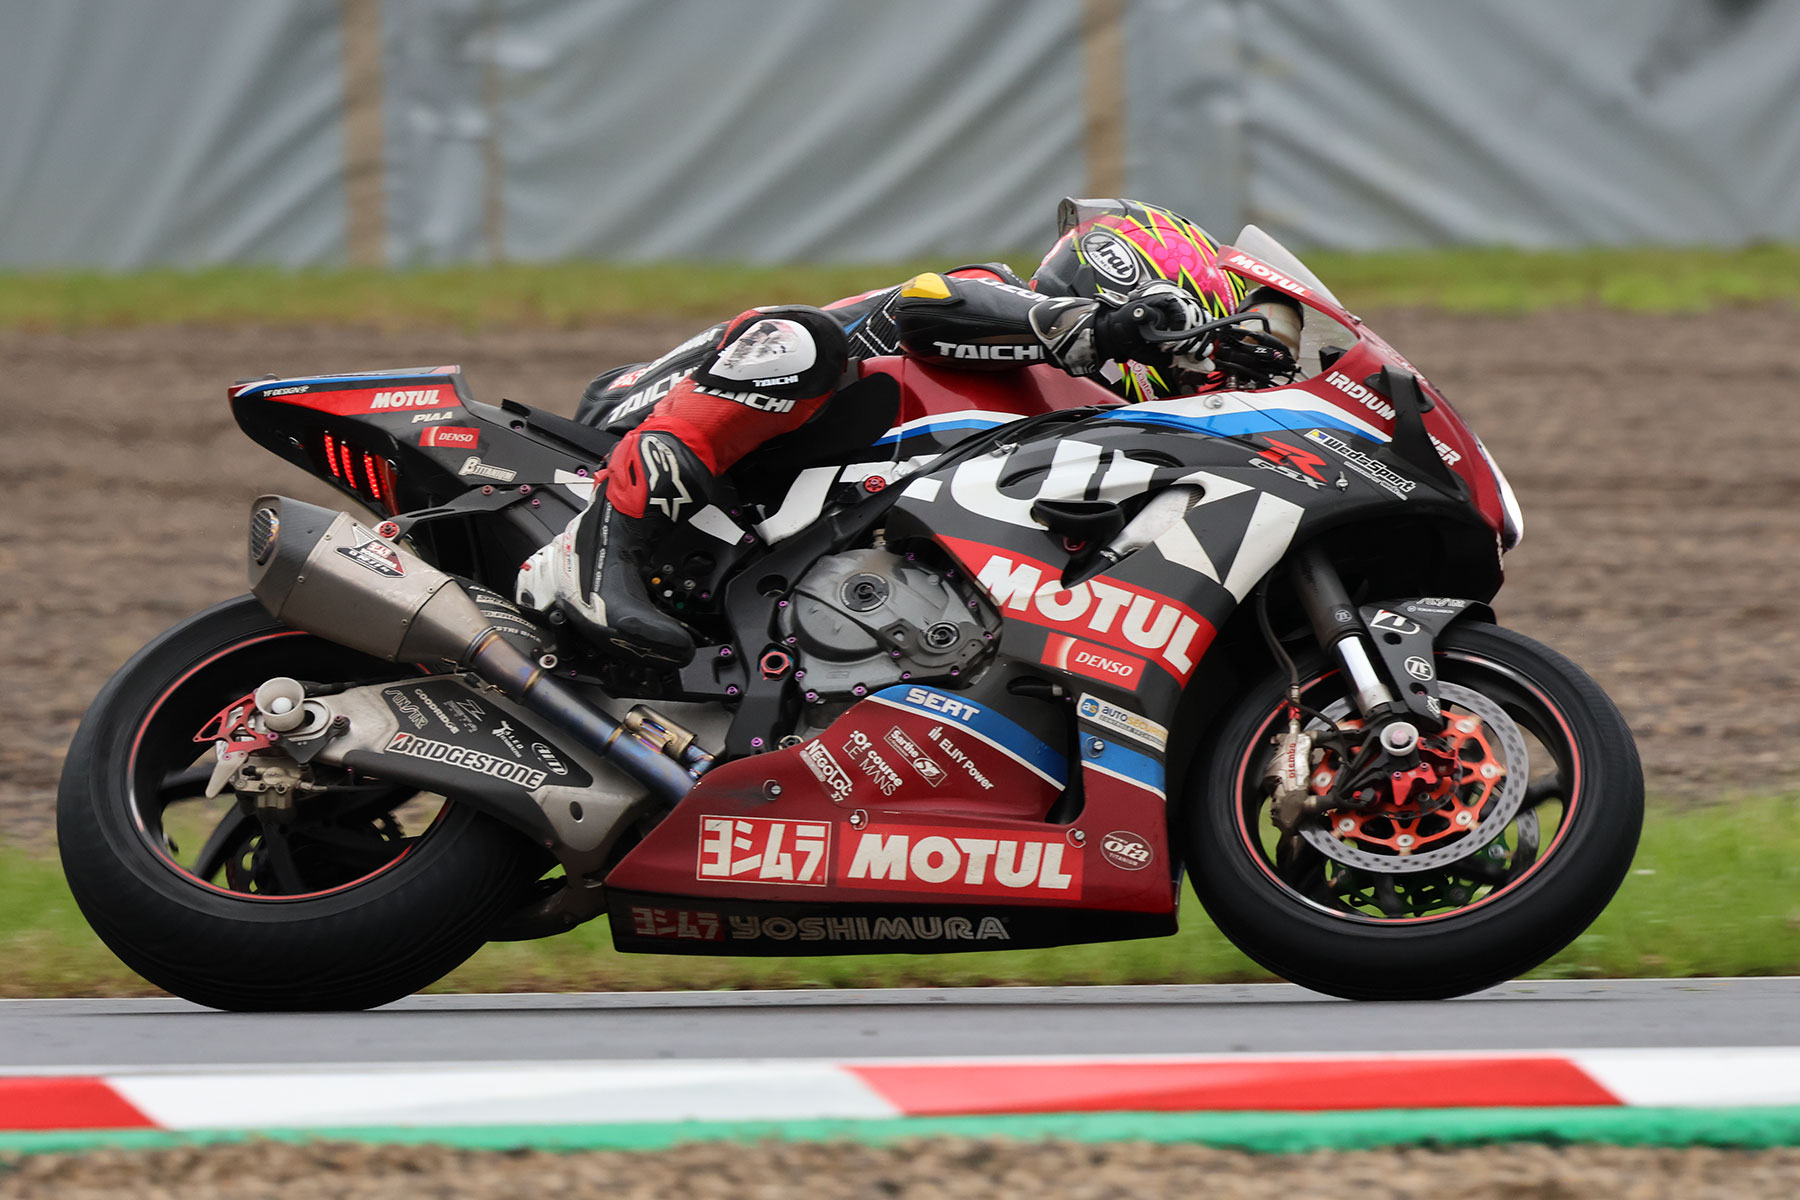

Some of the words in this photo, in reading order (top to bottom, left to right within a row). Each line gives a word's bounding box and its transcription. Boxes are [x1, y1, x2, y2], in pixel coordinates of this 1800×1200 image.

[1085, 241, 1134, 276] Arai
[1229, 255, 1307, 296] MOTUL
[752, 375, 799, 388] TAICHI
[1325, 371, 1397, 421] IRIDIUM
[370, 389, 440, 409] MOTUL
[411, 411, 453, 424] PIAA
[438, 432, 474, 443] DENSO
[1323, 436, 1416, 492] WedsSport
[977, 554, 1200, 675] MOTUL
[1074, 651, 1134, 677] DENSO
[414, 688, 460, 734] GOODRIDGE
[905, 688, 981, 721] SERT
[386, 732, 547, 790] BRIDGESTONE
[891, 730, 919, 758] Sarthe
[842, 739, 864, 760] LE
[859, 758, 896, 796] MANS
[868, 750, 903, 787] course
[962, 760, 994, 790] Power
[830, 791, 845, 802] 37
[702, 818, 826, 882] ヨシムラ
[847, 833, 1074, 890] MOTUL
[632, 907, 719, 939] ヨシムラ
[729, 914, 1010, 941] YOSHIMURA
